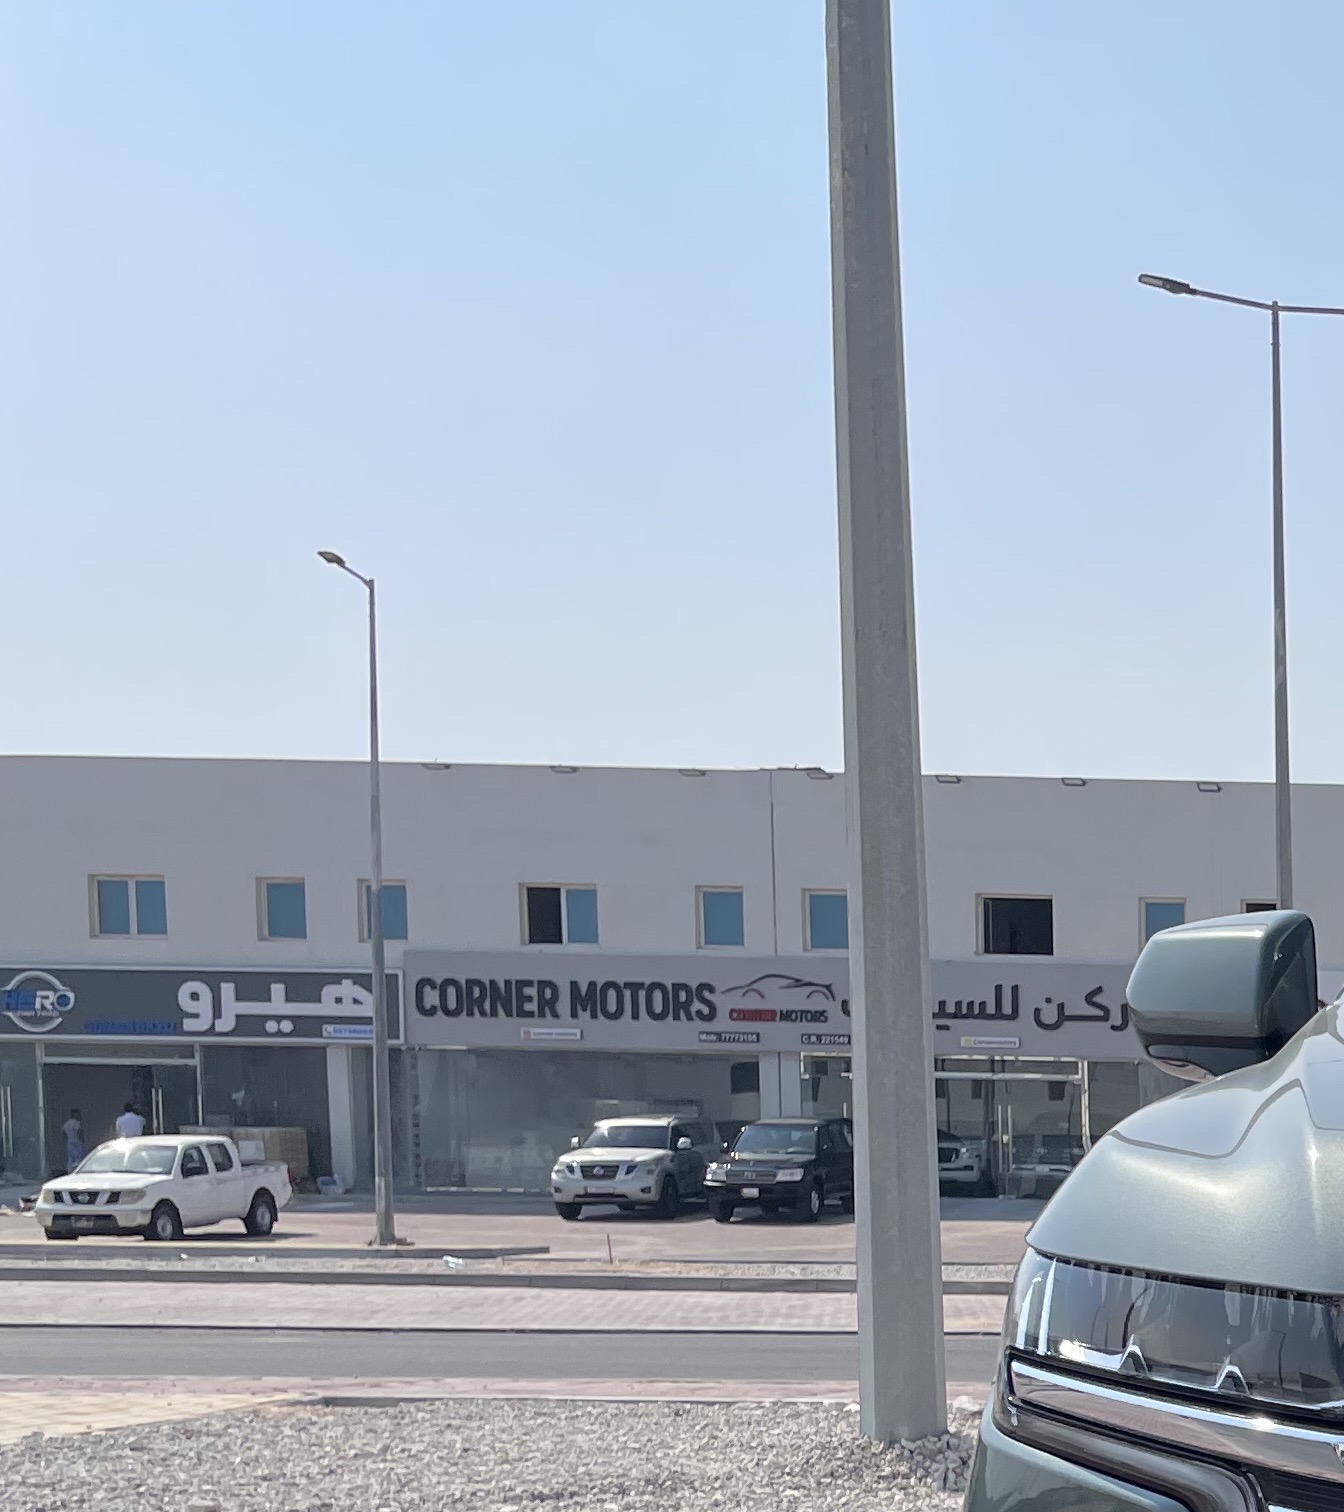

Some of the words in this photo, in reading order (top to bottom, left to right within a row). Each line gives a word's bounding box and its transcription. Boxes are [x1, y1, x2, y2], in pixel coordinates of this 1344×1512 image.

[177, 979, 374, 1033] هيرو
[415, 977, 560, 1019] CORNER
[569, 980, 718, 1022] MOTORS
[779, 1009, 828, 1023] MOTORS
